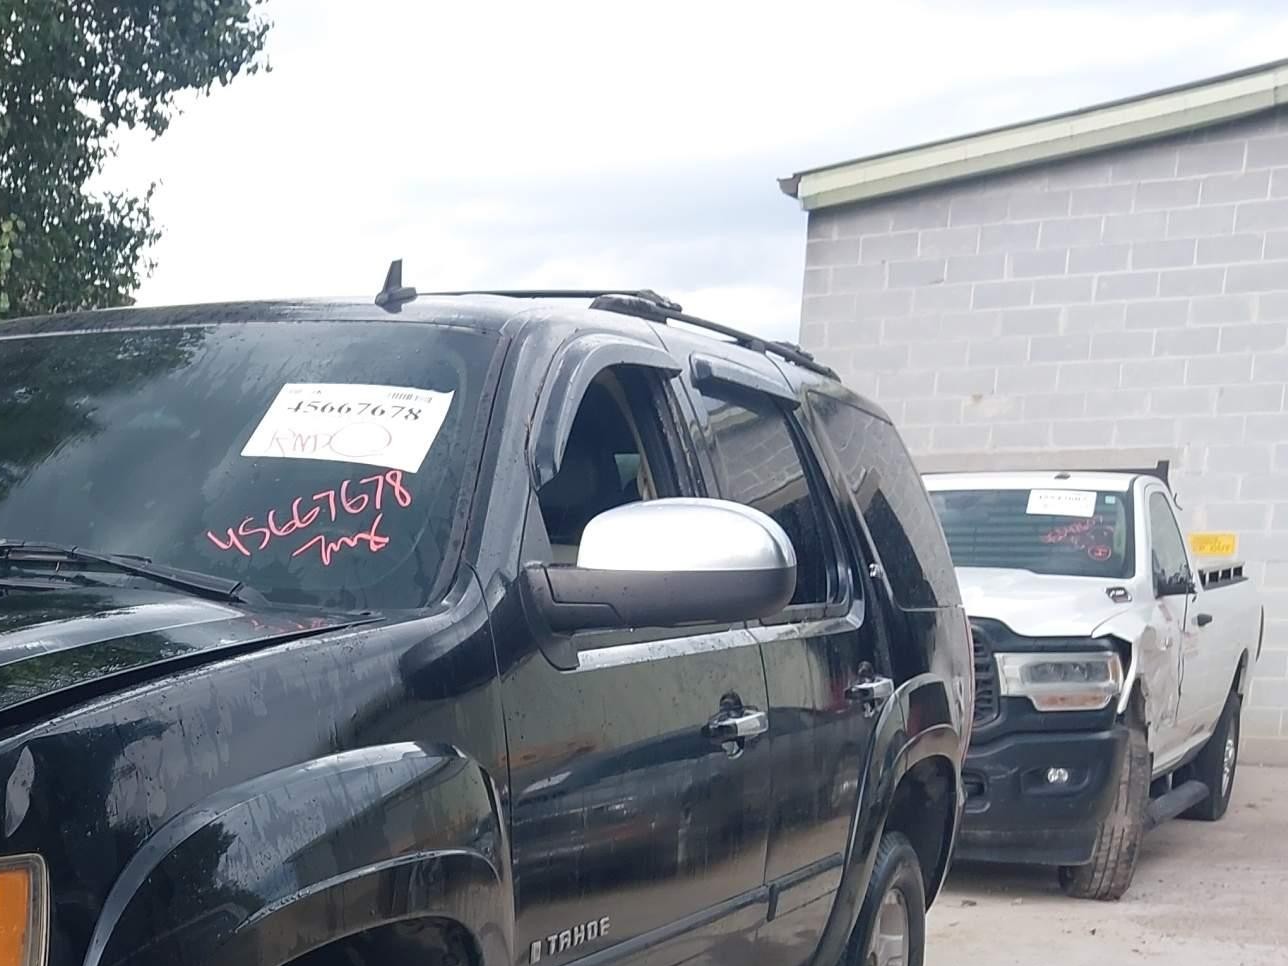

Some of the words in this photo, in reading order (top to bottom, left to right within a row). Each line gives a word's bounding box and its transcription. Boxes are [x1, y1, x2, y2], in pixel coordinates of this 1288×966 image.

[287, 401, 423, 422] 45667678
[206, 469, 412, 557] 45667678
[547, 915, 611, 956] TAHOE
